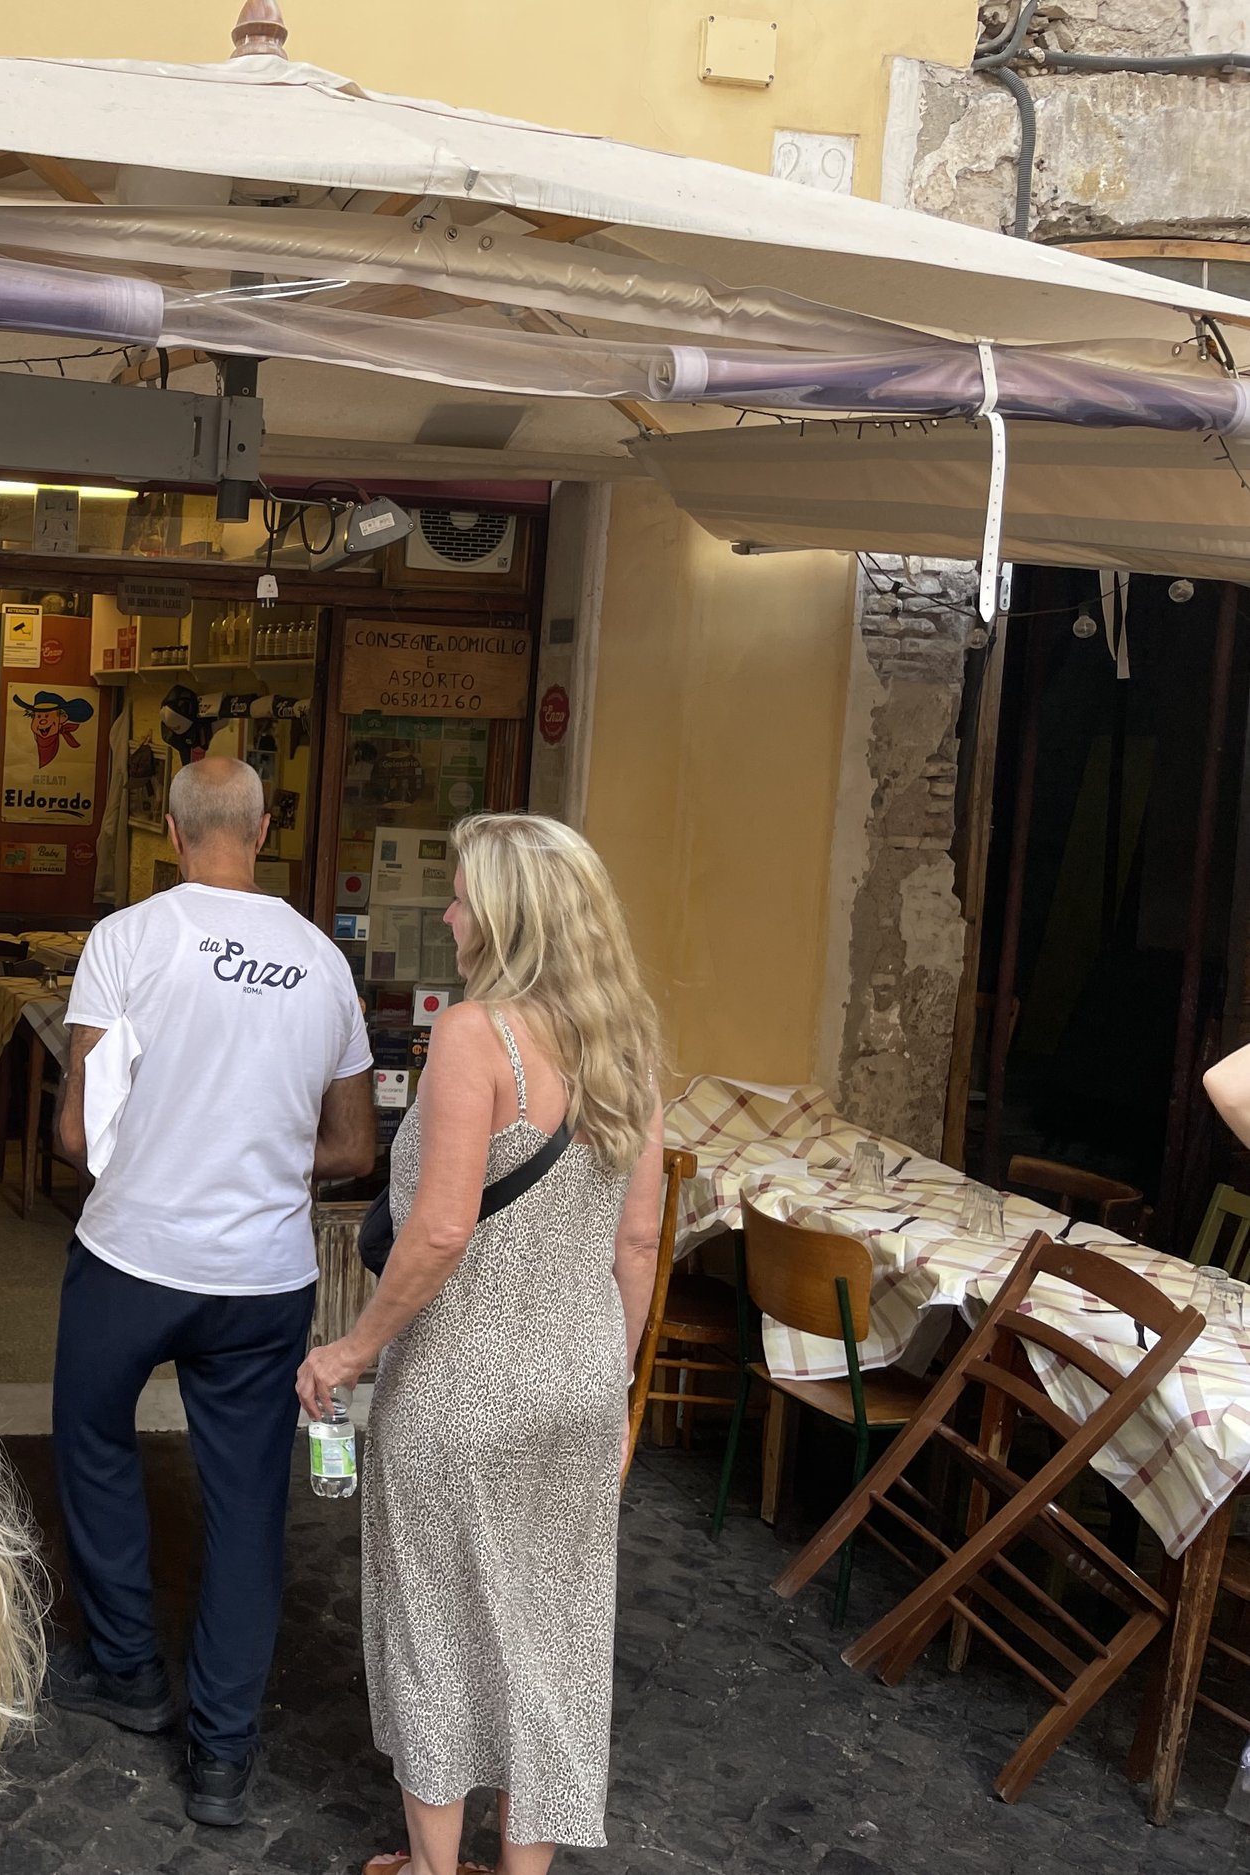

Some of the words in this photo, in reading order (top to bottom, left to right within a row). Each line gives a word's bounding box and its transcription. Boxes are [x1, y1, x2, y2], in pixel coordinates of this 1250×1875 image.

[354, 631, 438, 651] CONSEGNE
[447, 635, 527, 656] DOMICILIO
[426, 655, 435, 669] E
[388, 670, 475, 691] ASPORTO
[380, 691, 482, 711] 065812260
[33, 775, 67, 786] GELATI
[4, 789, 92, 810] Eldorado
[37, 845, 61, 858] Baby
[199, 937, 222, 952] da
[213, 938, 307, 989] Enzo
[242, 986, 263, 996] ROMA
